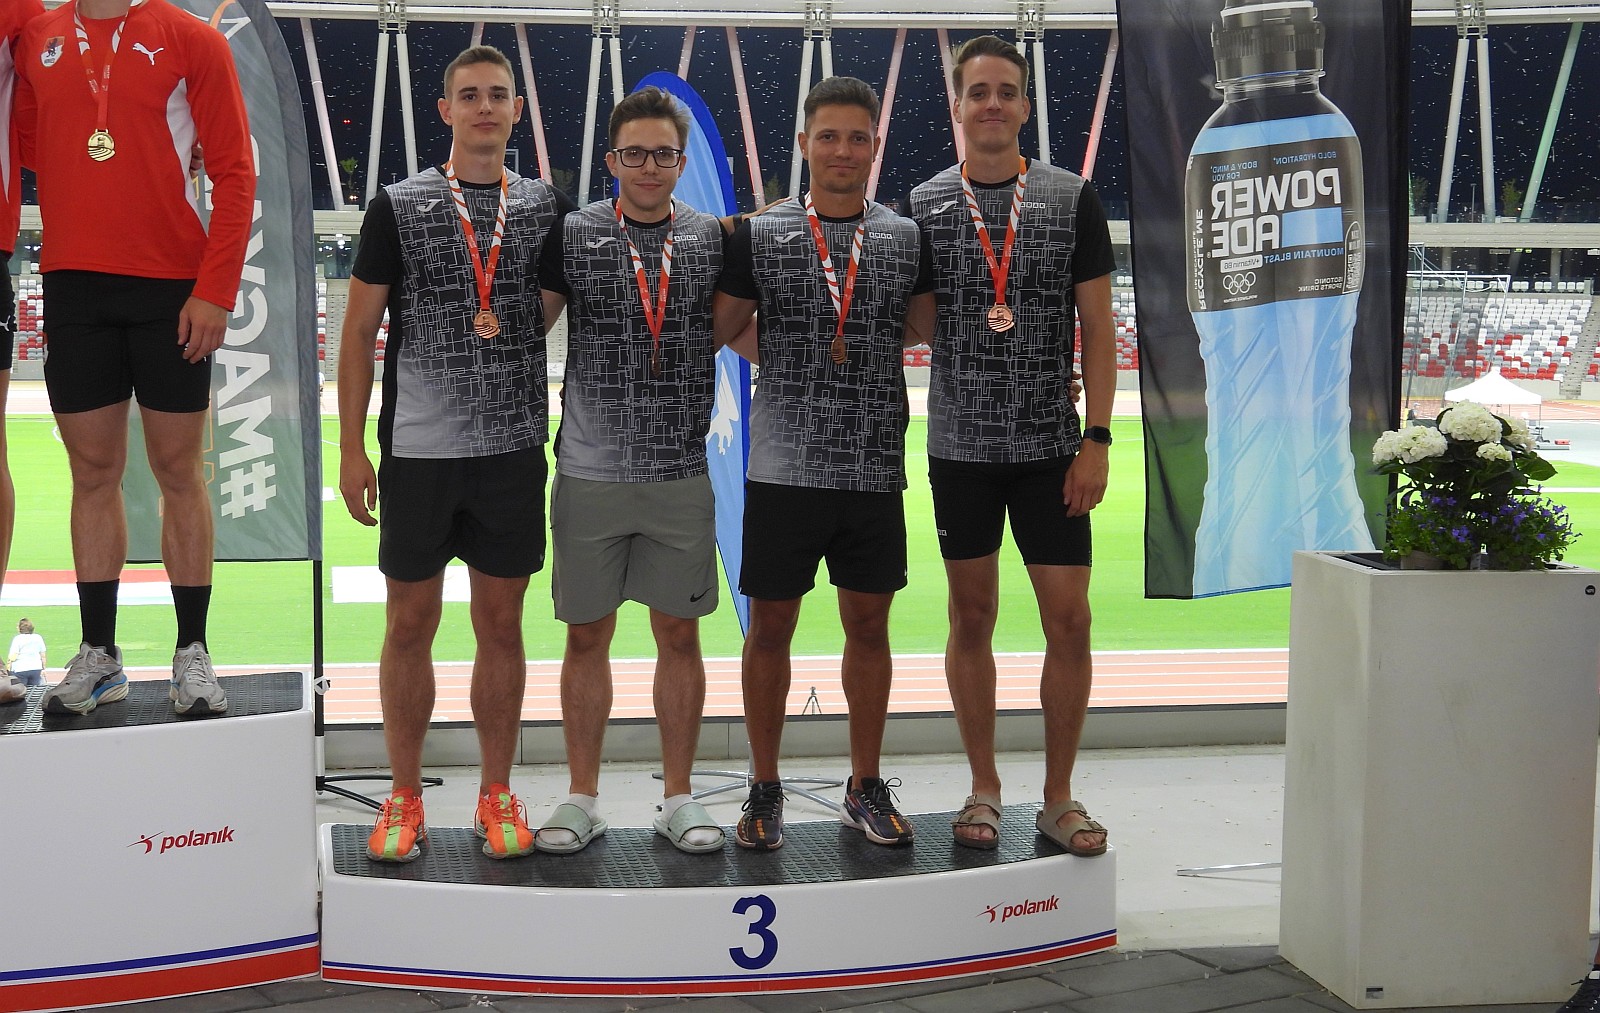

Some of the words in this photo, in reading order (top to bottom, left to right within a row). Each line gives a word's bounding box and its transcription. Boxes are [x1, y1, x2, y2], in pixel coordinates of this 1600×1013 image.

[159, 825, 235, 855] polanik
[1001, 894, 1060, 923] polanik
[728, 894, 778, 971] 3
